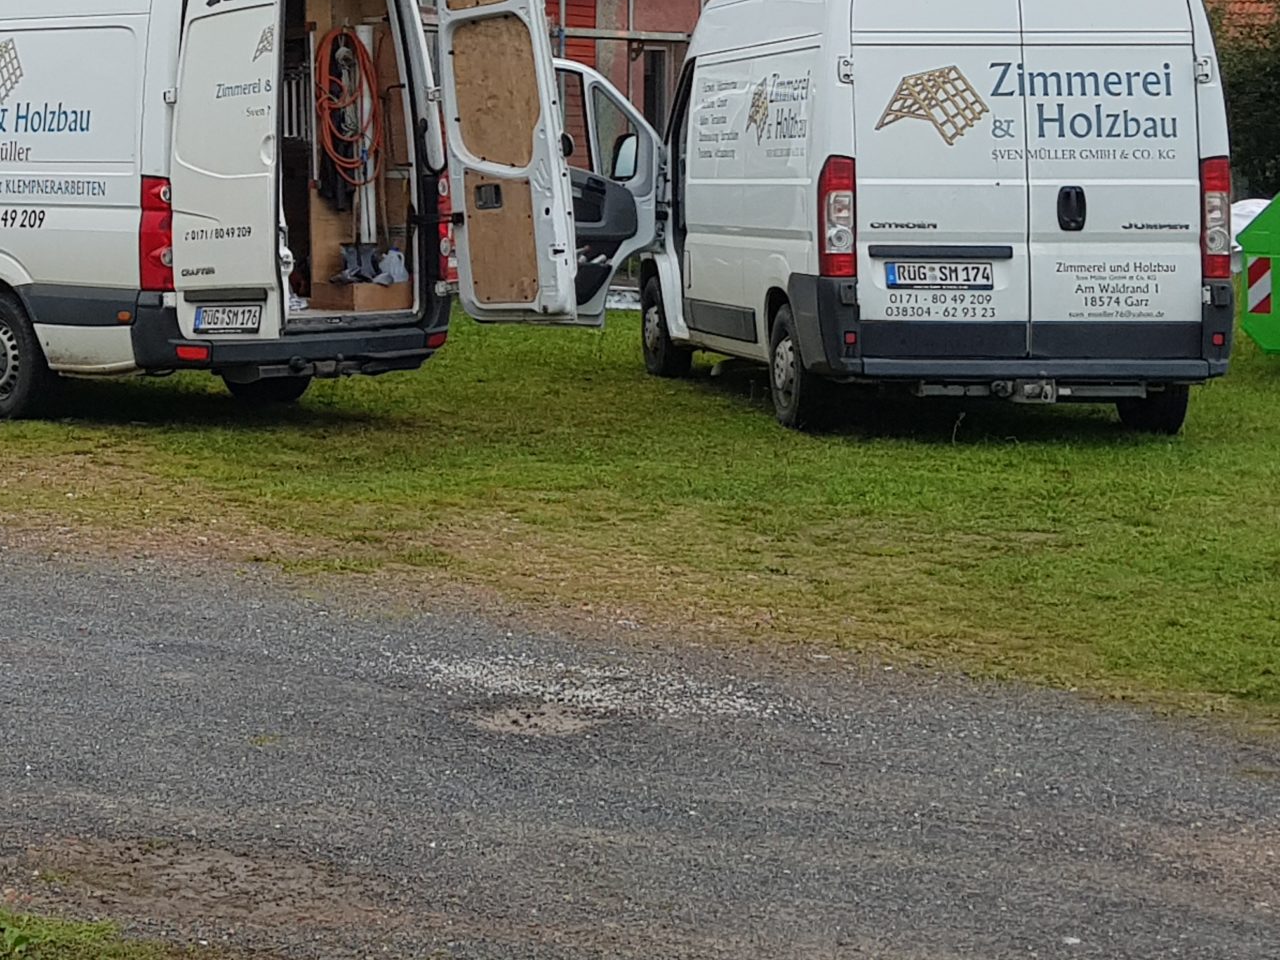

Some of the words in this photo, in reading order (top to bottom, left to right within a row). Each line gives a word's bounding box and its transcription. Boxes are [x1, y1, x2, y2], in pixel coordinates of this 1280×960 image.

[988, 61, 1173, 97] Zimmerei
[215, 78, 261, 99] Zimmerei
[14, 101, 91, 133] Holzbau
[991, 118, 1015, 139] &
[1036, 102, 1178, 139] Holzbau
[991, 148, 1023, 160] SVEN
[1026, 147, 1077, 160] MÜLLER
[1079, 148, 1117, 160] GMBH
[1158, 148, 1176, 160] KG
[5, 179, 106, 197] KLEMPNERARBEITEN
[0, 209, 18, 228] 49
[19, 209, 46, 229] 209
[897, 265, 927, 281] RÜG
[939, 266, 959, 282] SM
[962, 266, 991, 282] 174
[1056, 262, 1106, 273] Zimmerei
[1109, 262, 1130, 273] und
[1133, 262, 1176, 273] Holzbau
[1074, 283, 1095, 294] Am
[1098, 283, 1149, 294] Waldrand
[889, 293, 919, 304] 0171
[931, 293, 947, 304] 80
[951, 294, 965, 305] 49
[970, 294, 992, 305] 209
[1084, 296, 1121, 307] 18574
[1124, 296, 1149, 307] Garz
[202, 308, 219, 326] RÜG
[225, 309, 240, 326] SM
[240, 308, 258, 326] 176
[885, 306, 931, 317] 038304
[943, 306, 958, 318] 62
[961, 307, 976, 318] 93
[981, 307, 996, 318] 23
